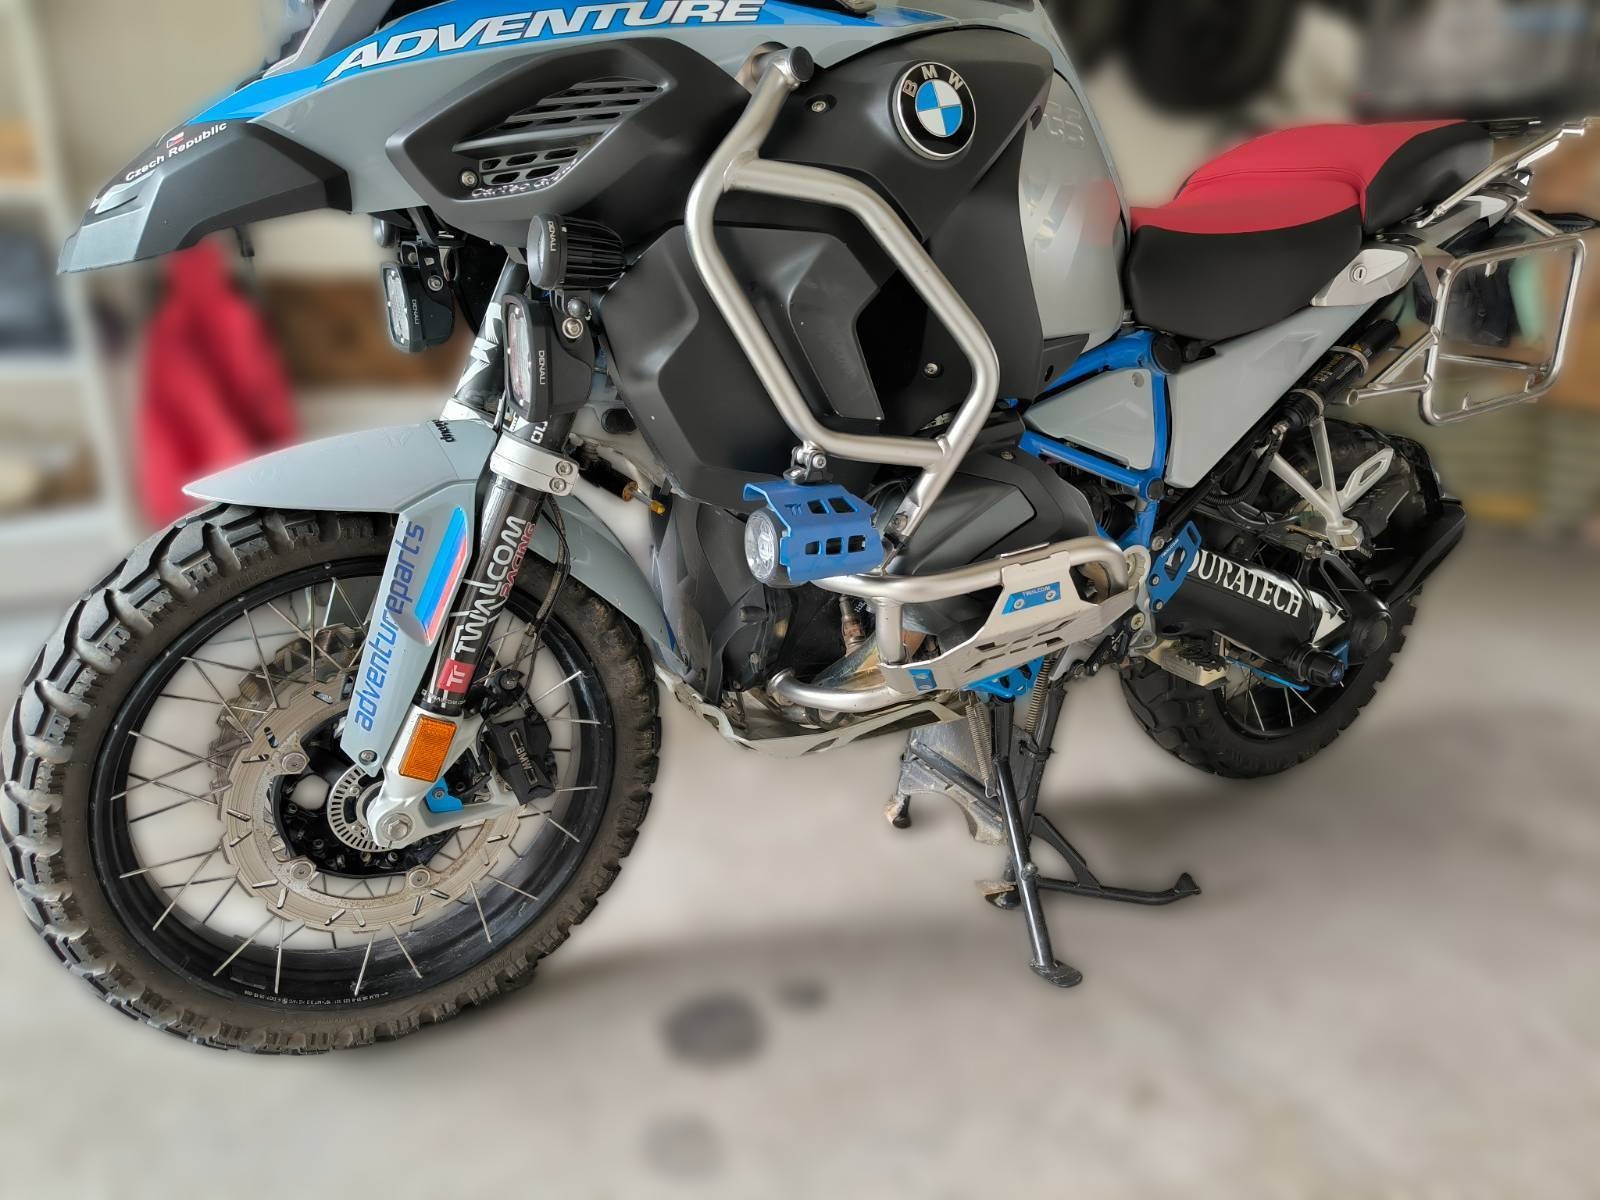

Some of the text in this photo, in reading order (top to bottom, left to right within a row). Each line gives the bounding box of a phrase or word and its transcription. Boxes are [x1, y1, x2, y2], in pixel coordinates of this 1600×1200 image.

[323, 0, 765, 83] ADVENTURE
[902, 64, 964, 98] BMW
[125, 122, 227, 182] Czech Republic
[548, 220, 557, 252] DENALI
[411, 298, 420, 325] DENALI
[538, 350, 546, 385] DENALI
[500, 521, 536, 598] RACING
[354, 520, 425, 732] adventureparts
[516, 747, 532, 770] BMW
